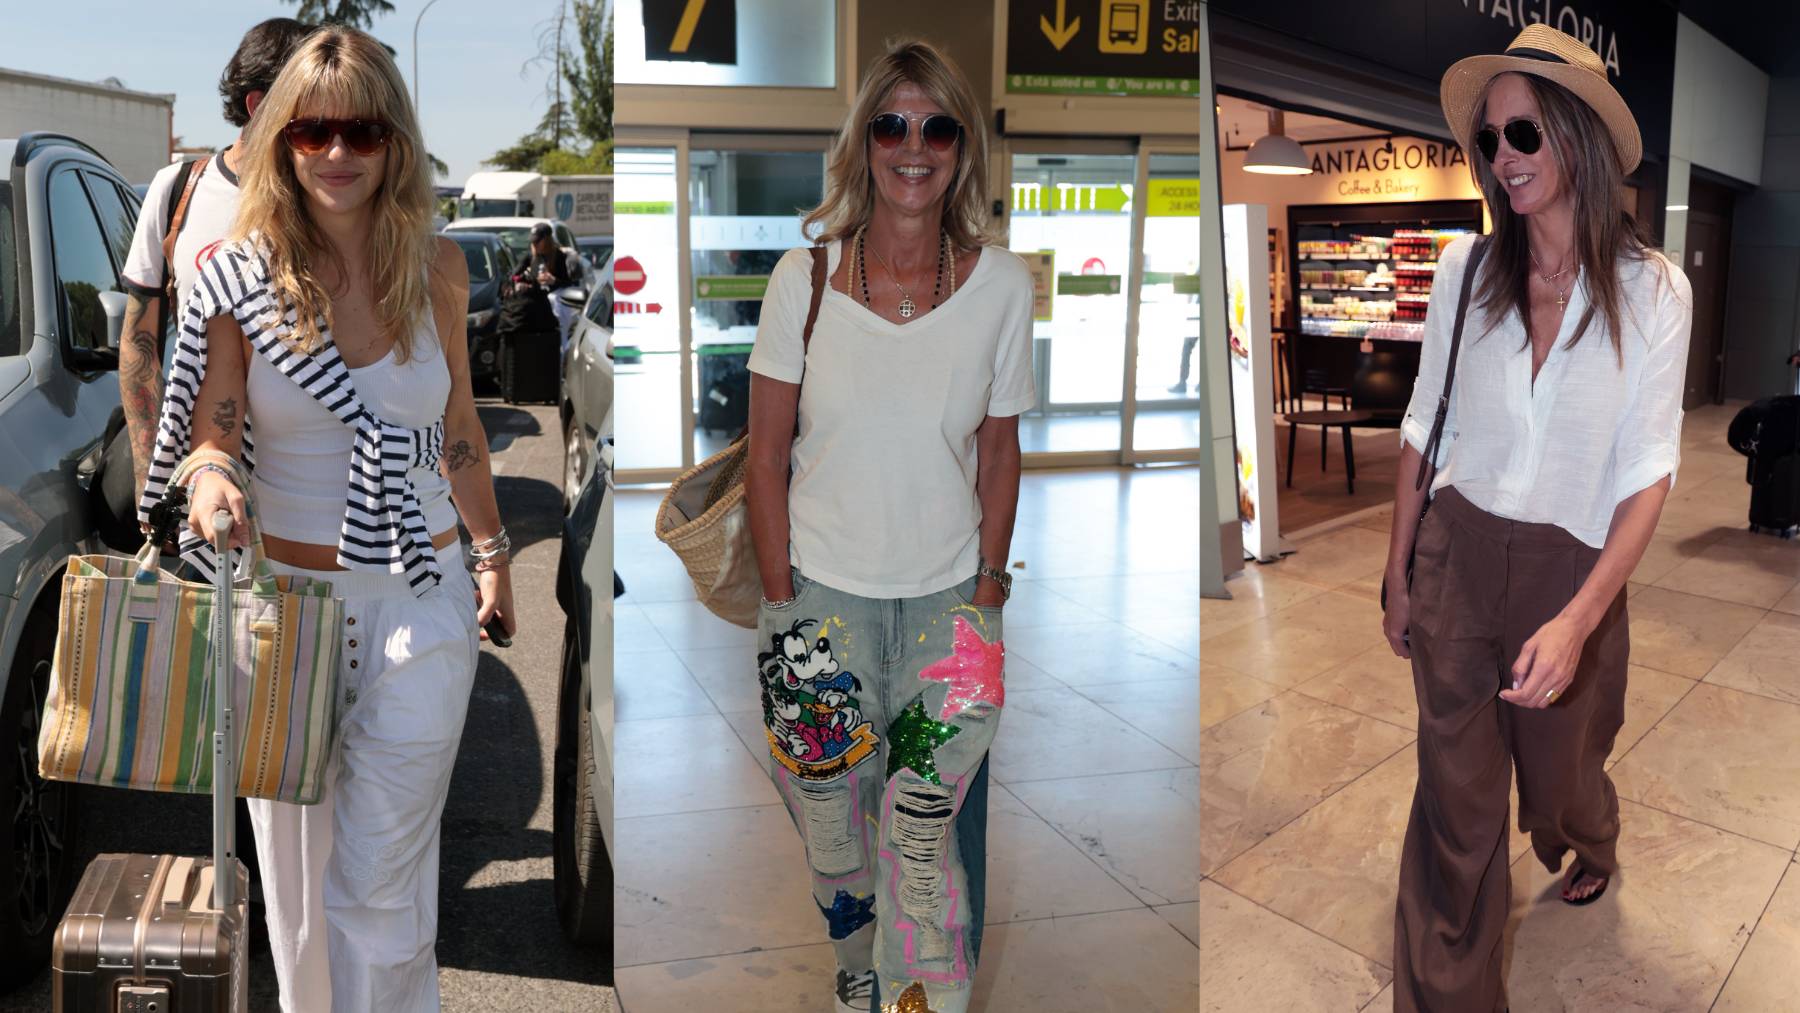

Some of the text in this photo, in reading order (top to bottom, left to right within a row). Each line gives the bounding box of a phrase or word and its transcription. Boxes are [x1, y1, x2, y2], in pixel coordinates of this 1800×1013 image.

[1164, 0, 1199, 21] Exit
[1162, 28, 1199, 52] Sal
[1338, 178, 1420, 197] Coffee & Bakery
